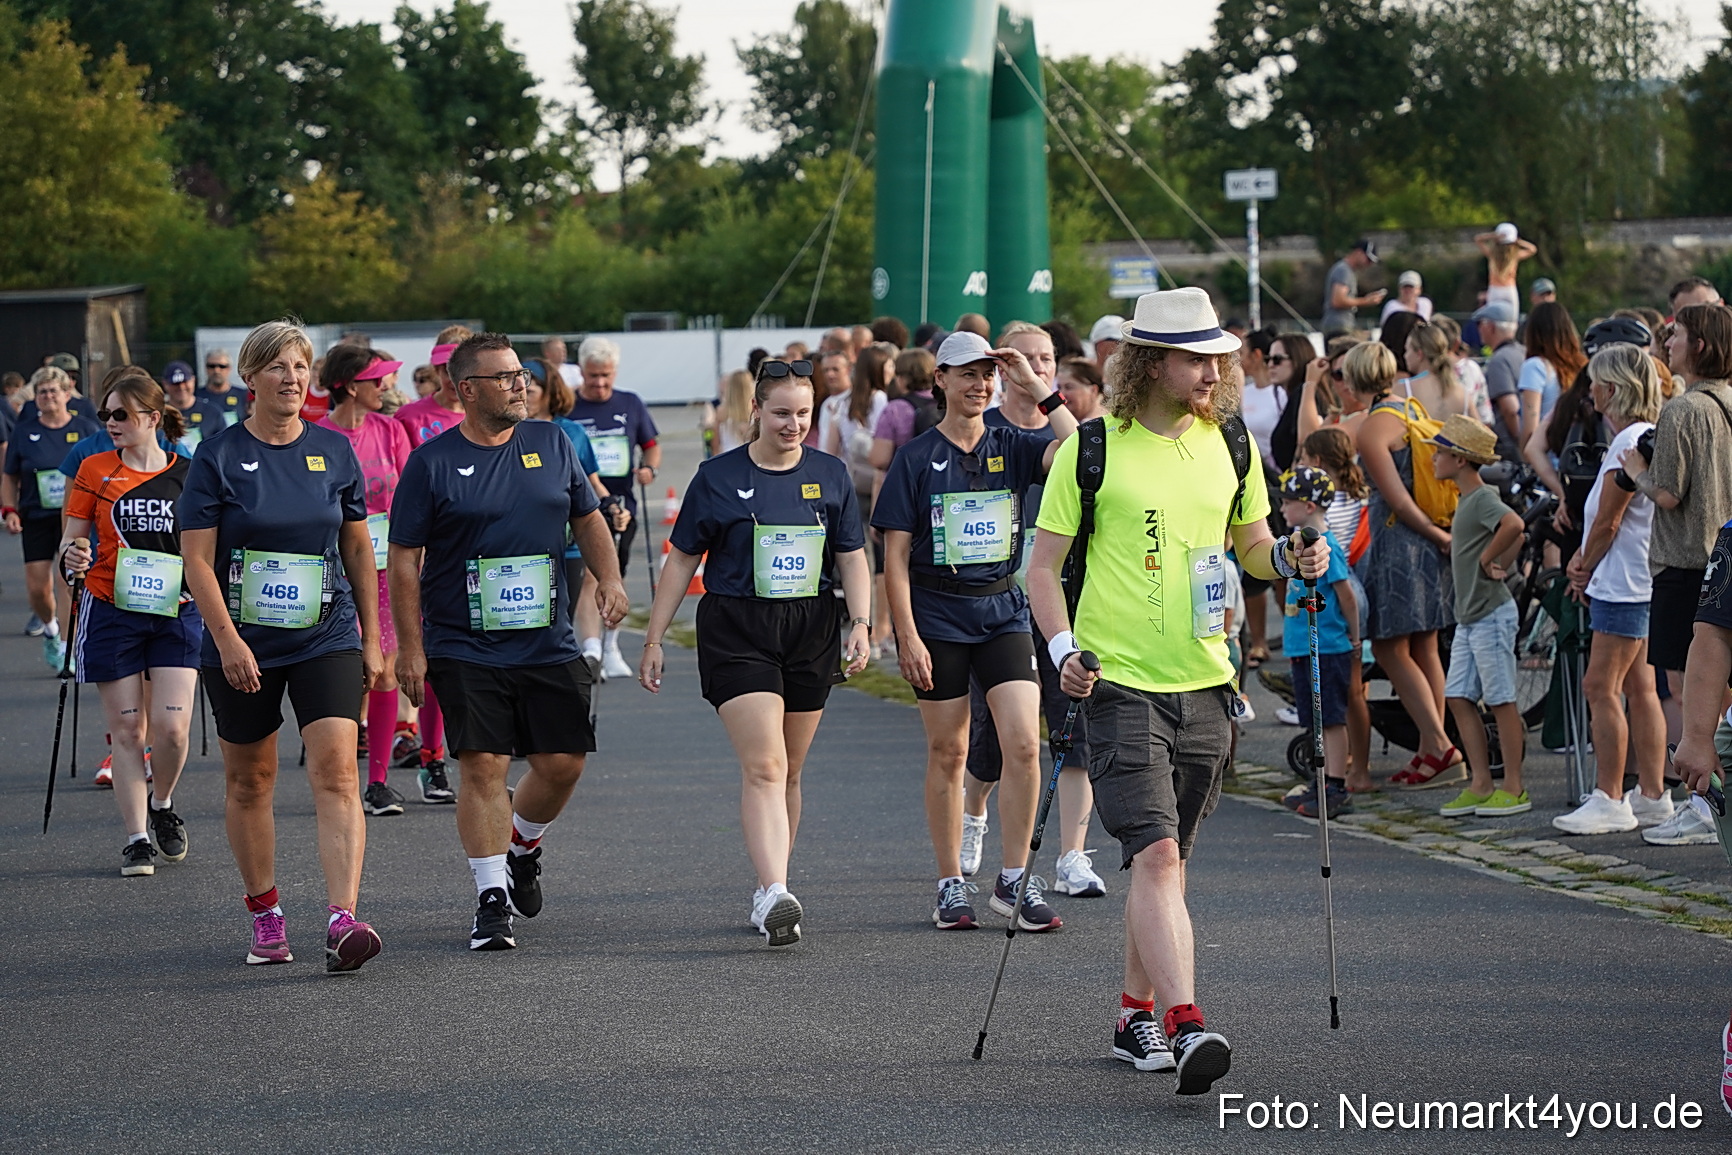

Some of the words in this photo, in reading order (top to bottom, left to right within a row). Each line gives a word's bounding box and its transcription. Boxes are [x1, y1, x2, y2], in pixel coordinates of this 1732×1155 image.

[962, 271, 988, 297] AO
[1027, 269, 1053, 293] AO
[120, 499, 174, 518] HECK
[120, 517, 174, 534] DESIGN
[963, 521, 996, 537] 465
[772, 556, 806, 571] 439
[131, 575, 164, 591] 1133
[127, 590, 153, 598] Rebecca
[261, 583, 299, 600] 468
[500, 586, 535, 602] 463
[1205, 581, 1225, 602] 122
[256, 601, 287, 610] Christina
[288, 602, 306, 611] Weiß
[491, 605, 516, 613] Markus
[516, 603, 545, 612] Schönfeld
